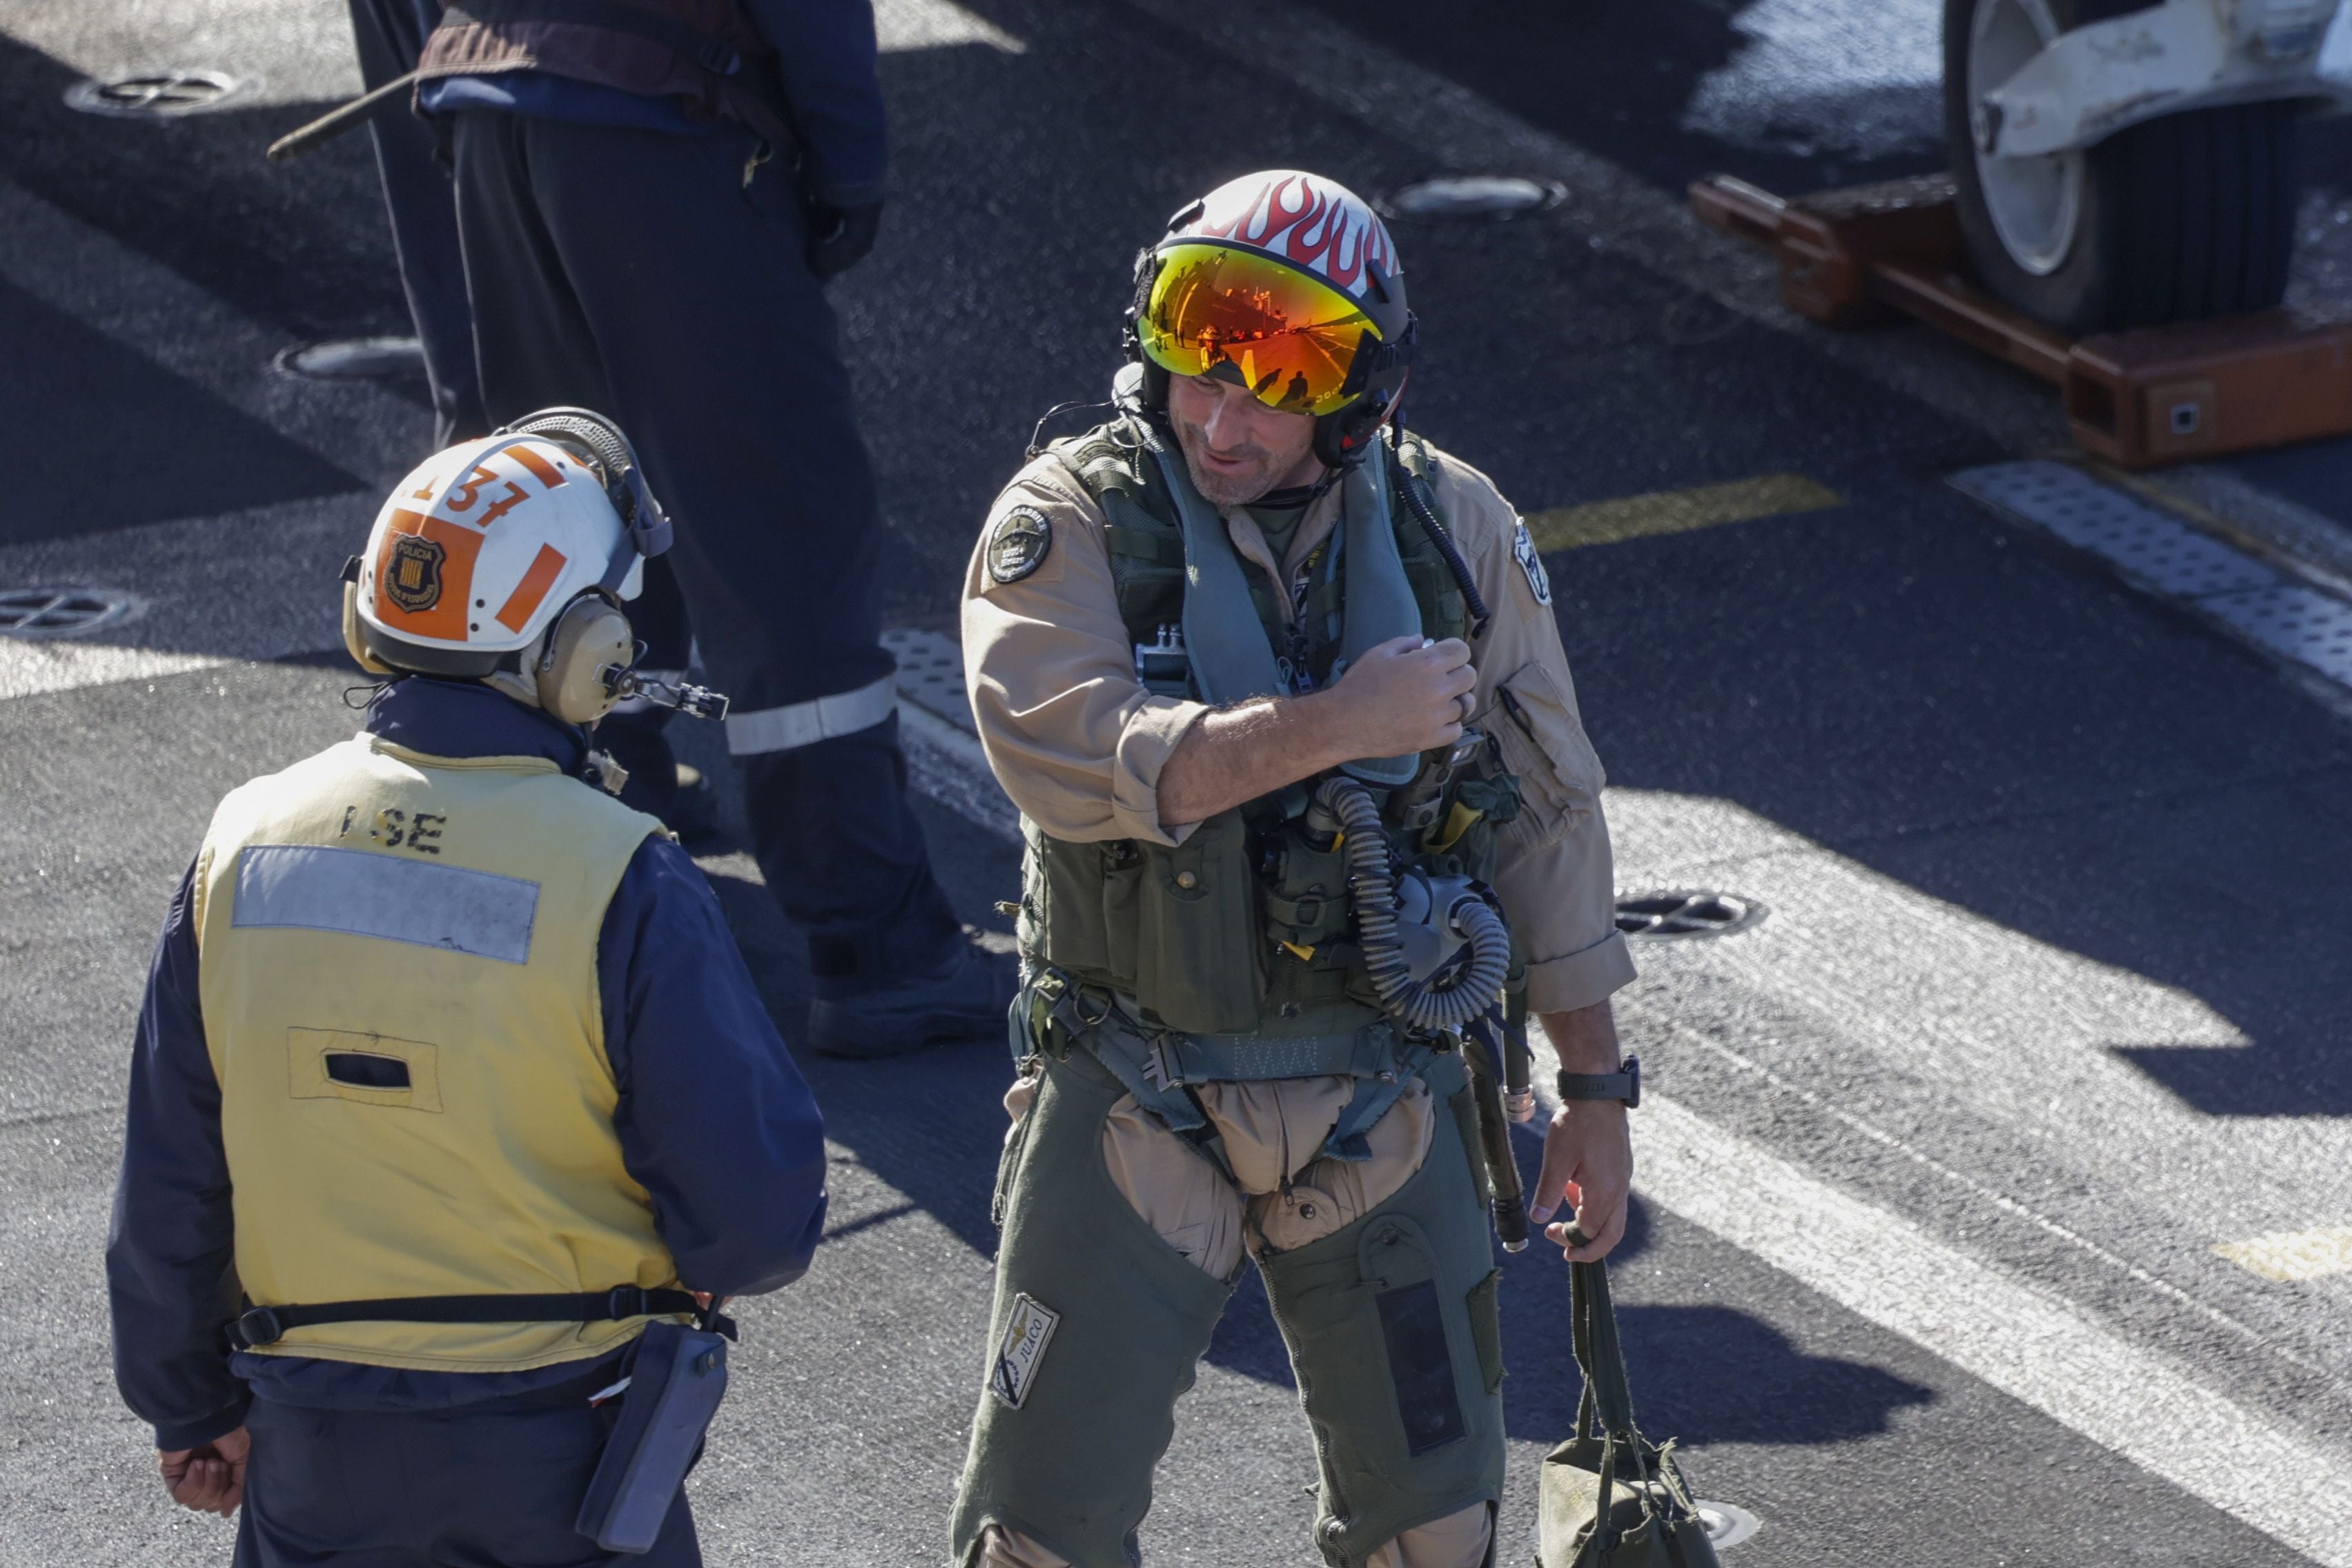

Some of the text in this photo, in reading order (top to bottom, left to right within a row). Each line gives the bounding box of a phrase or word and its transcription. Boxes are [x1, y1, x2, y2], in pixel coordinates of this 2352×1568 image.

[1012, 507, 1048, 531] HARRIER
[398, 542, 433, 560] POLICIA
[1020, 1319, 1042, 1363] JUACO
